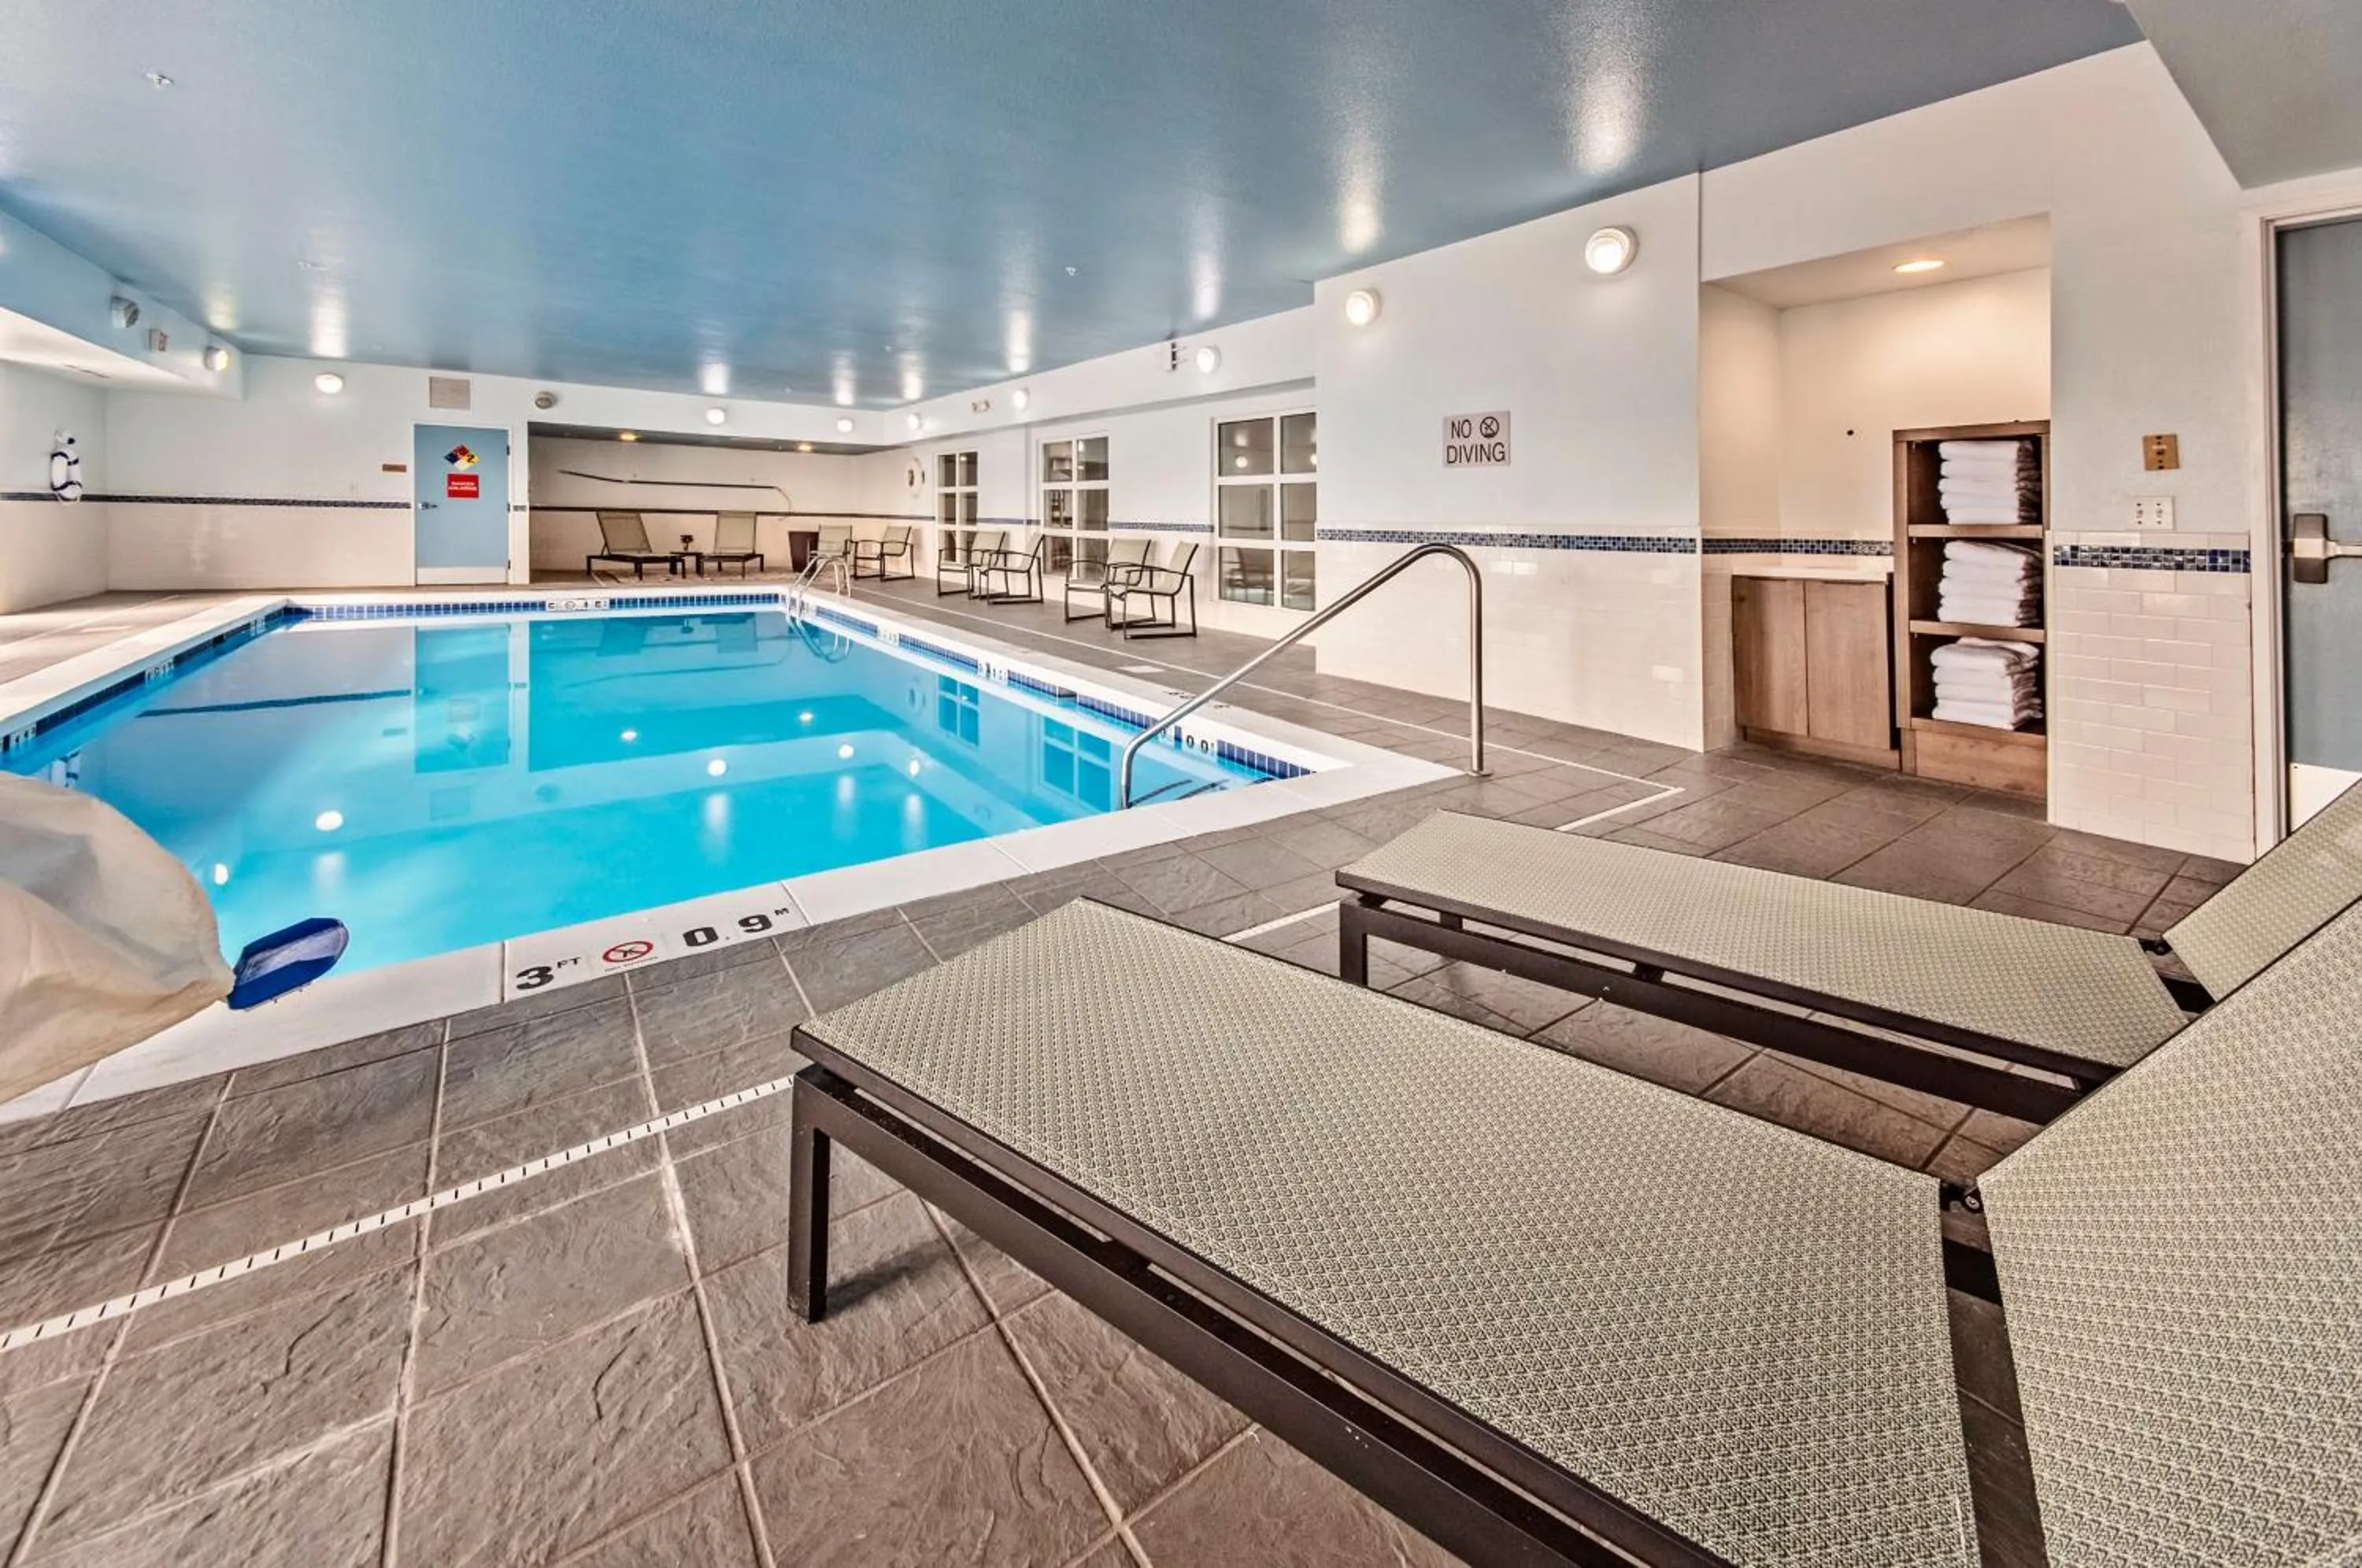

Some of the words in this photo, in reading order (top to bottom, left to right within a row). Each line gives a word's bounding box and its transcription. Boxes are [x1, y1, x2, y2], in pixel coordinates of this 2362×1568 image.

[1451, 419, 1472, 439] NO
[1446, 442, 1505, 464] DIVING
[516, 966, 554, 989] 3
